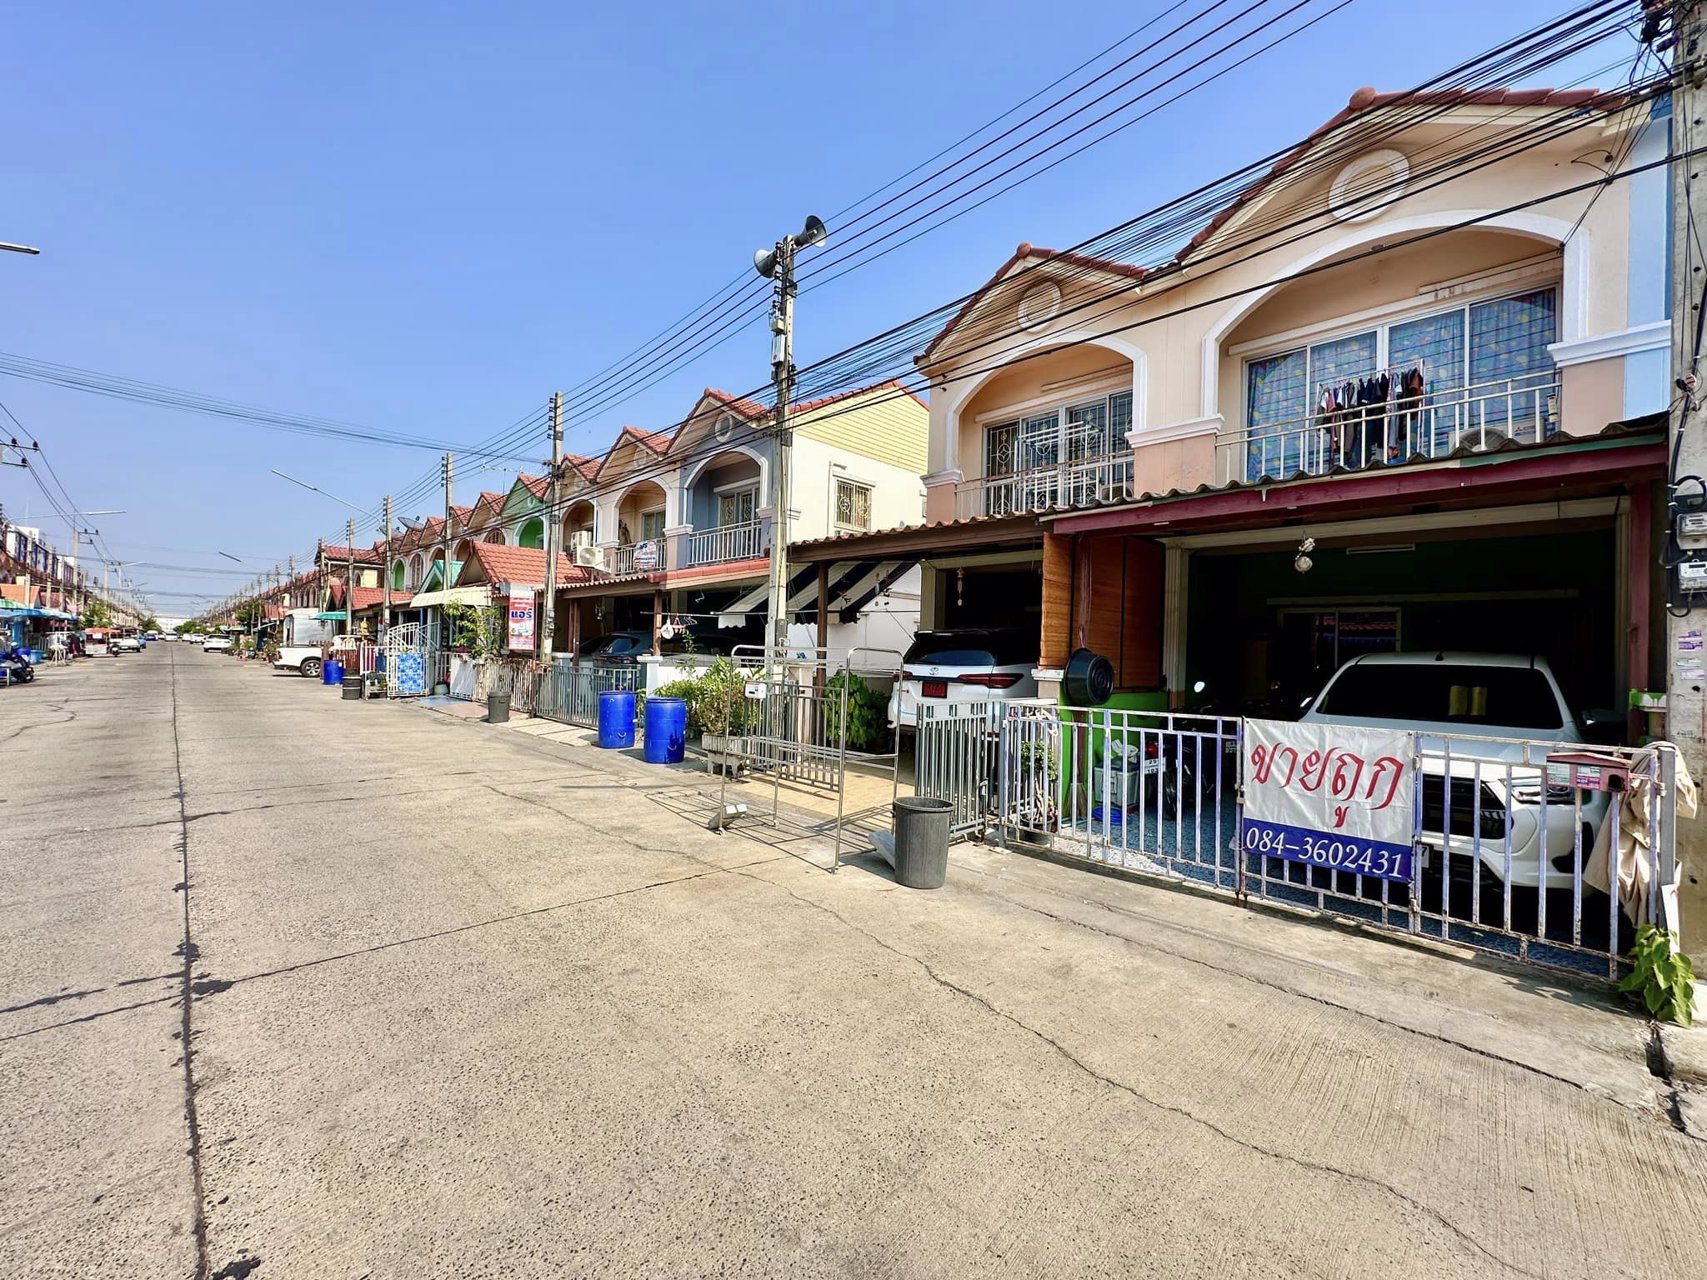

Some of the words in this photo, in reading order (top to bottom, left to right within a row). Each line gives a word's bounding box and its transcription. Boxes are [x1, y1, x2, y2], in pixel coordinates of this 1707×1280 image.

[1250, 742, 1405, 829] ขายถูก
[1245, 827, 1403, 878] 084-3602431
